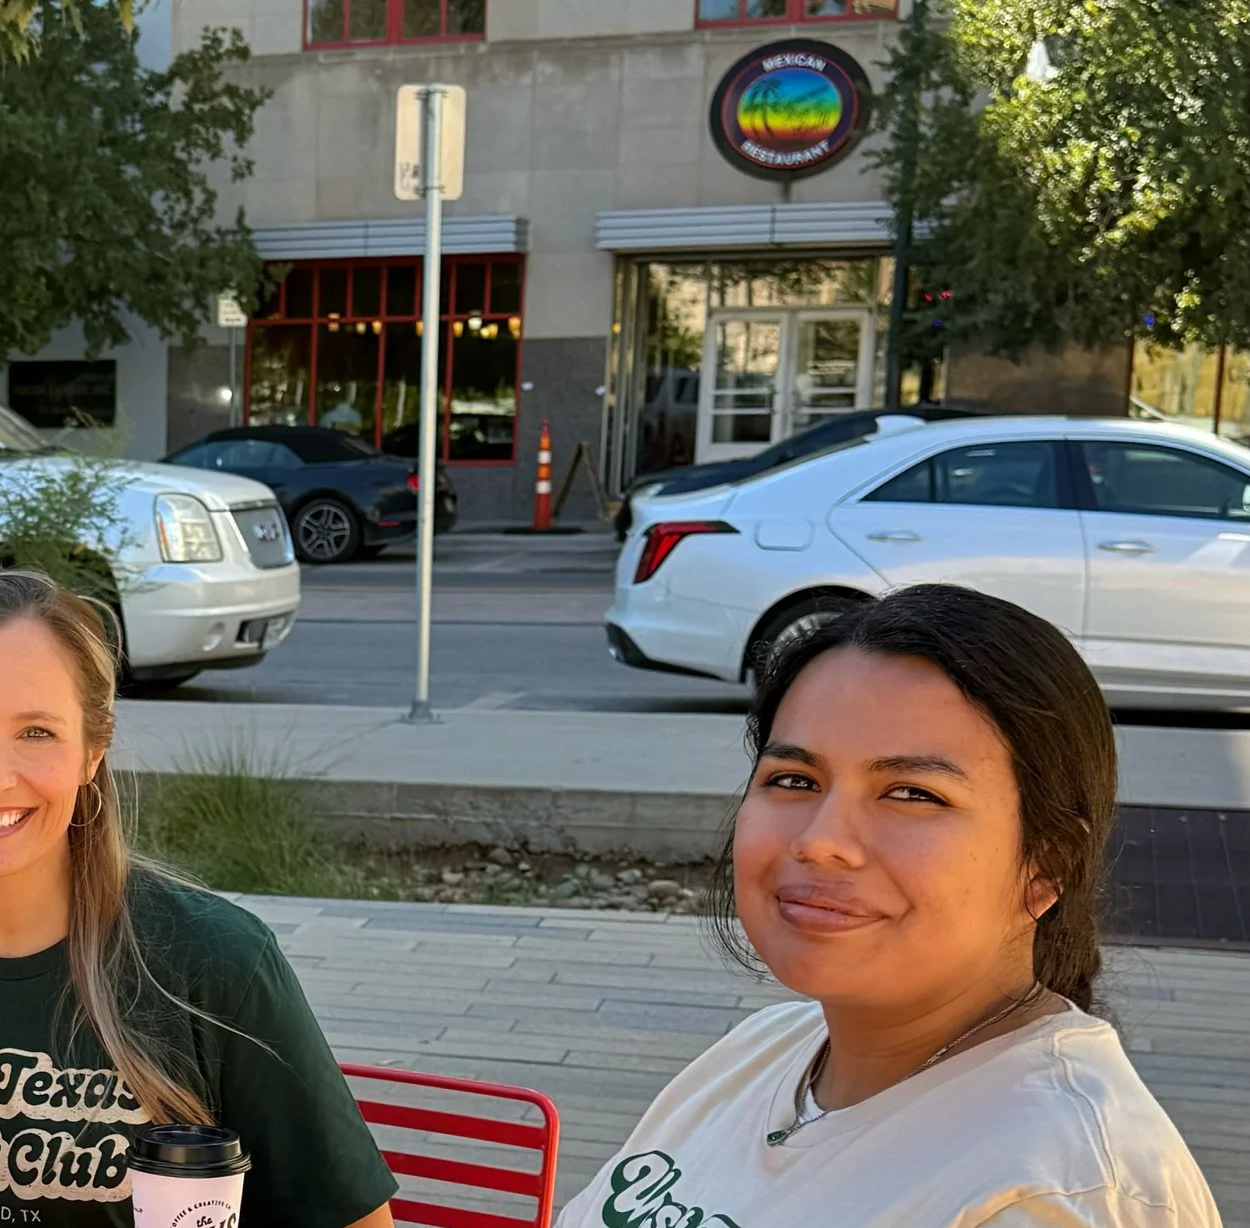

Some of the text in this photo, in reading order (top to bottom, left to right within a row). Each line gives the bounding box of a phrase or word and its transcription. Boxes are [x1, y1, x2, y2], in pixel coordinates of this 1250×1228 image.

[762, 53, 827, 72] MEXICAN
[741, 139, 831, 166] RESTAURANT
[9, 1128, 133, 1203] Club
[20, 1209, 41, 1223] TX
[196, 1216, 213, 1228] the
